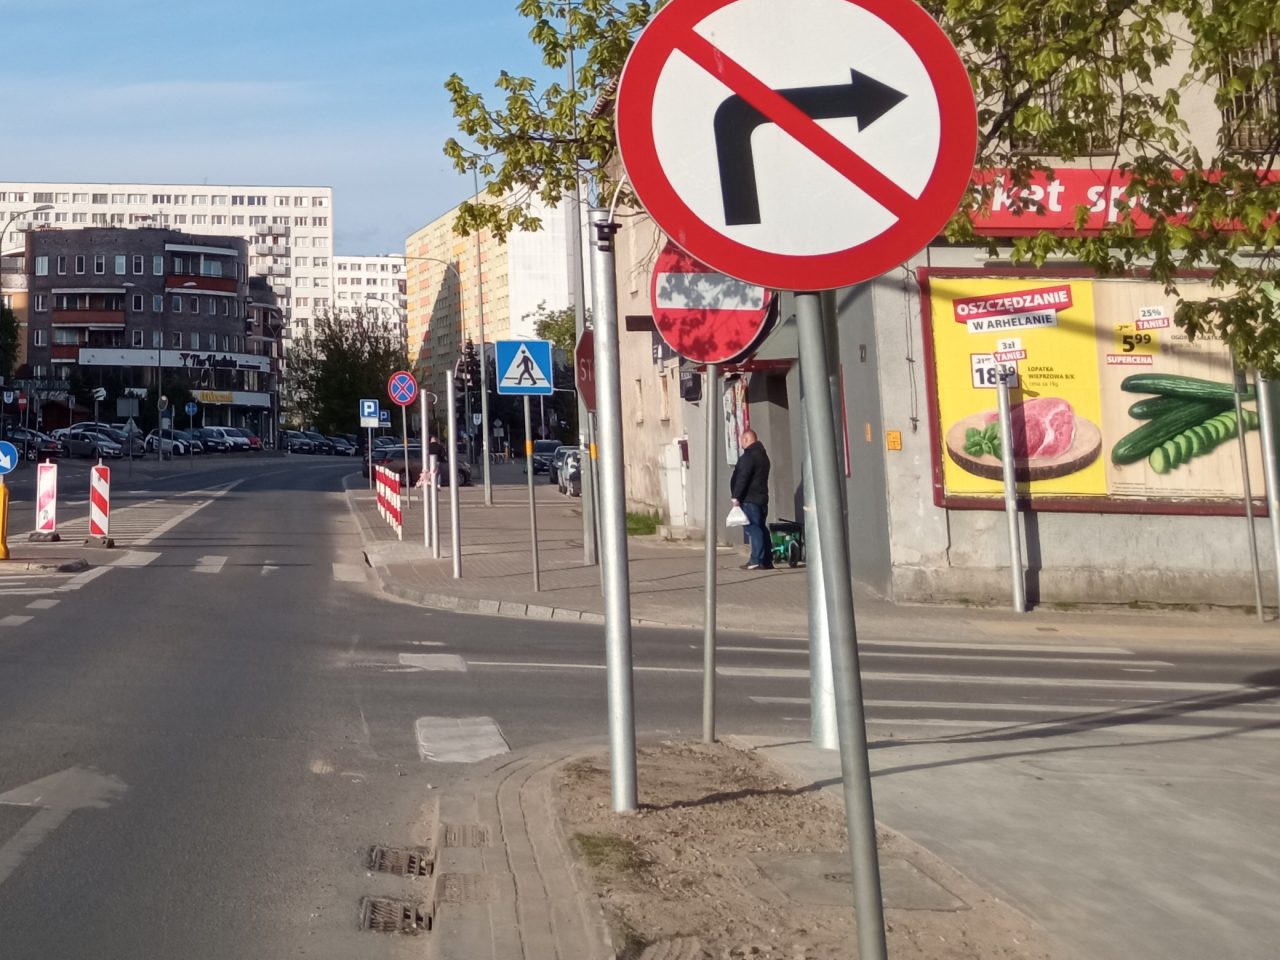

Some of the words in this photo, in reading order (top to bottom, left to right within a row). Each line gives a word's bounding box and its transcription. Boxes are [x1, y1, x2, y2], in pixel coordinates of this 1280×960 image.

[956, 290, 1069, 316] OSZCZĘDZANIE
[1141, 309, 1162, 318] 25%
[972, 321, 984, 331] W
[987, 314, 1053, 329] ARHELANIE
[1137, 319, 1168, 330] TANIEJ
[995, 351, 1025, 362] TANIEJ
[363, 401, 375, 416] P
